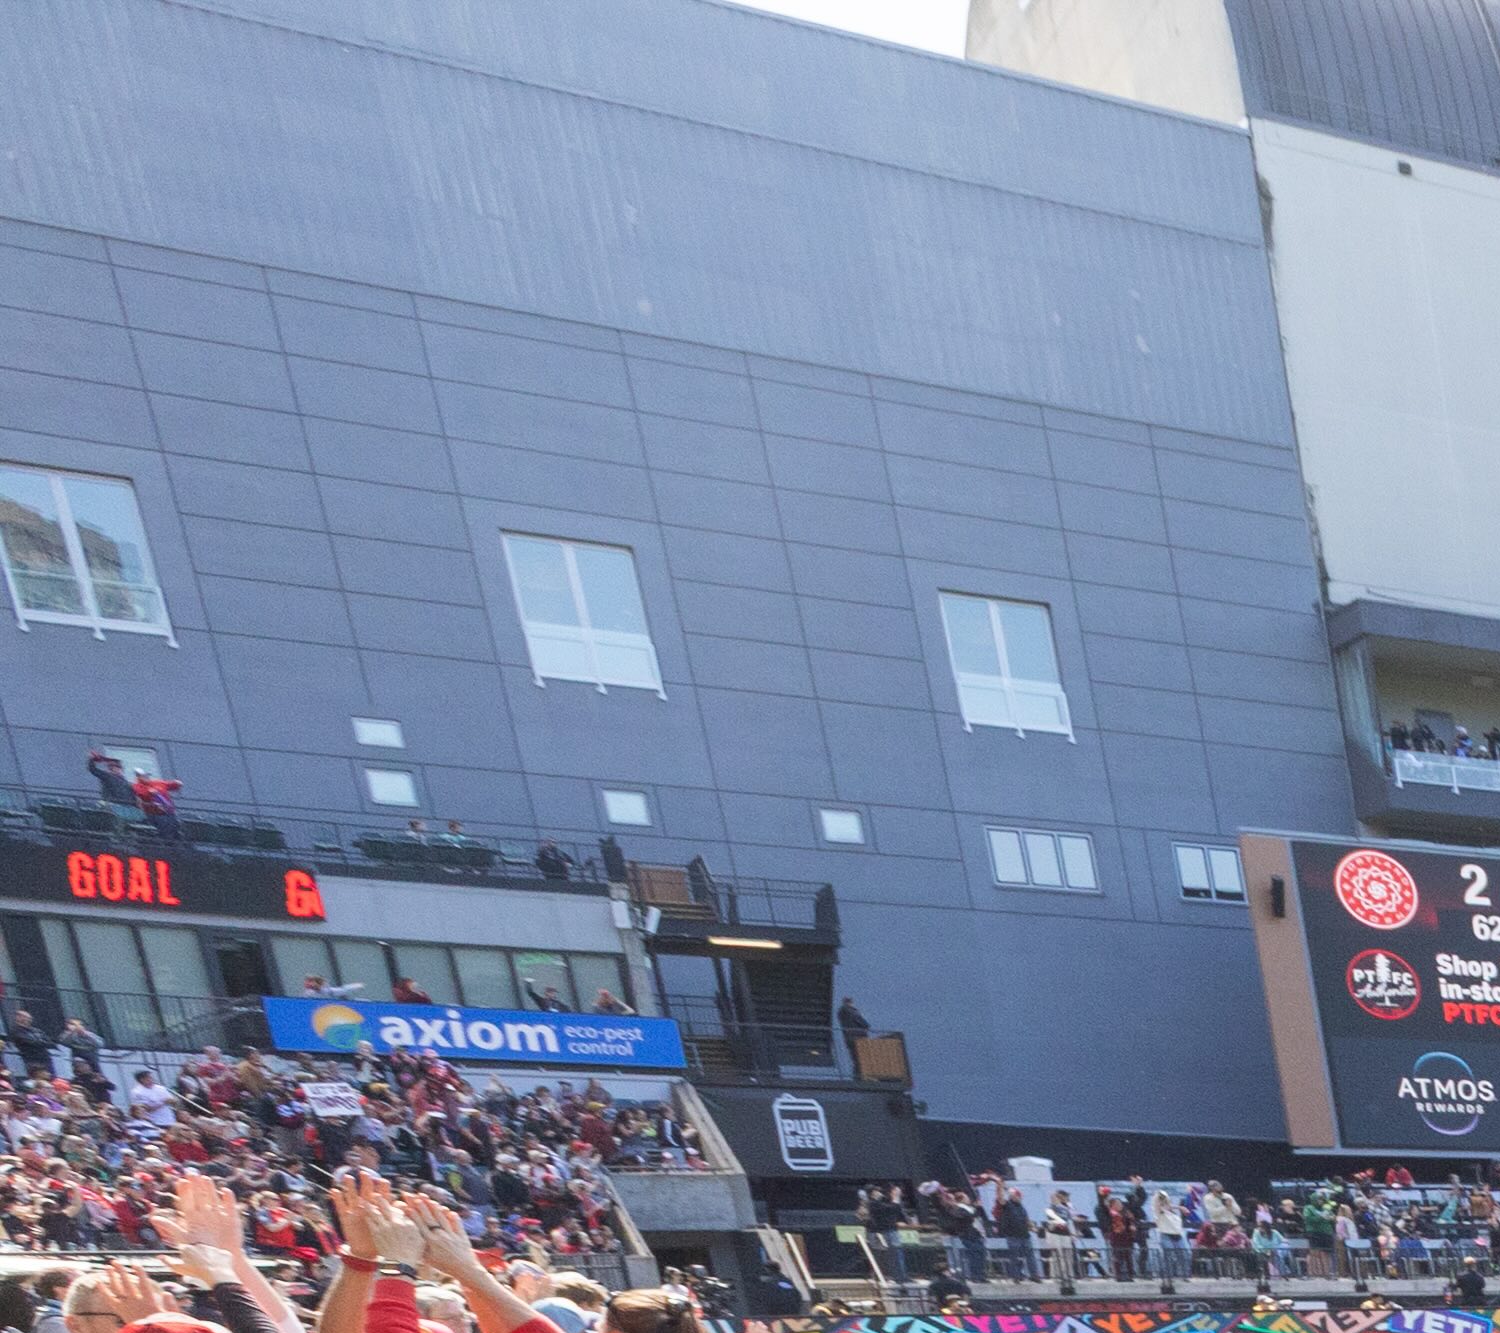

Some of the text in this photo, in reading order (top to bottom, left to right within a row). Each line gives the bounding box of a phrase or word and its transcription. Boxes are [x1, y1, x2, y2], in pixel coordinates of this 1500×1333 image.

[67, 851, 182, 906] GOAL
[1459, 863, 1492, 906] 2
[1436, 953, 1497, 981] Shop
[379, 1009, 561, 1053] axiom
[564, 1024, 645, 1043] eco-pest
[568, 1039, 635, 1057] control
[1398, 1077, 1496, 1102] ATMOS
[1415, 1102, 1486, 1115] REWARDS
[782, 1120, 821, 1135] PUB
